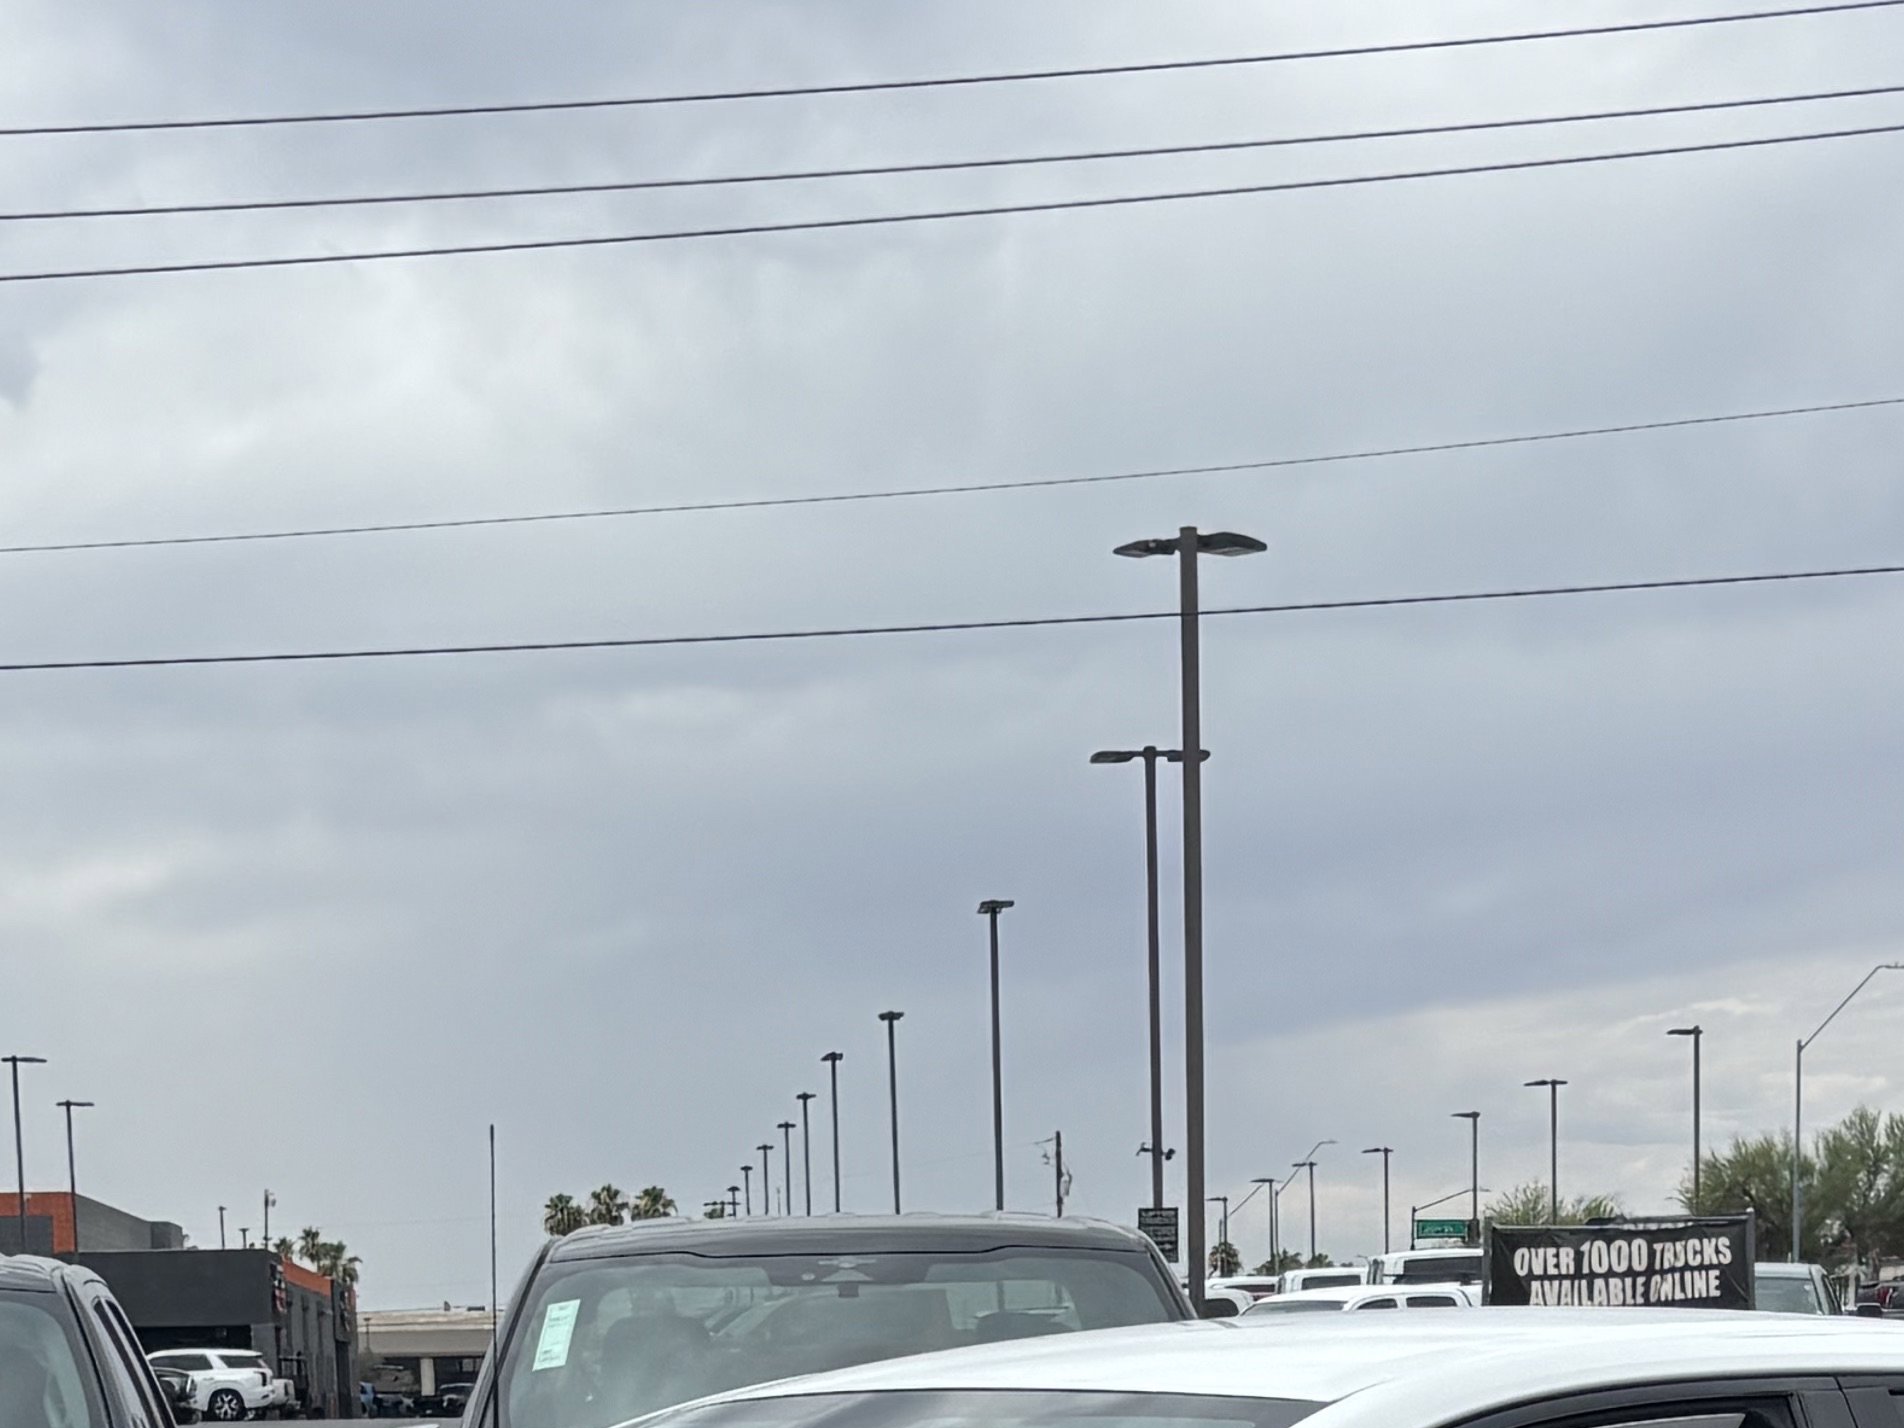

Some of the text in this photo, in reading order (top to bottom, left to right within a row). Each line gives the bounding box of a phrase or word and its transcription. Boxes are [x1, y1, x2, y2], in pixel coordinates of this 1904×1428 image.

[1513, 1237, 1733, 1277] OVER 1000 TRUCKS
[1528, 1269, 1721, 1307] AVAILABLE ONLINE
